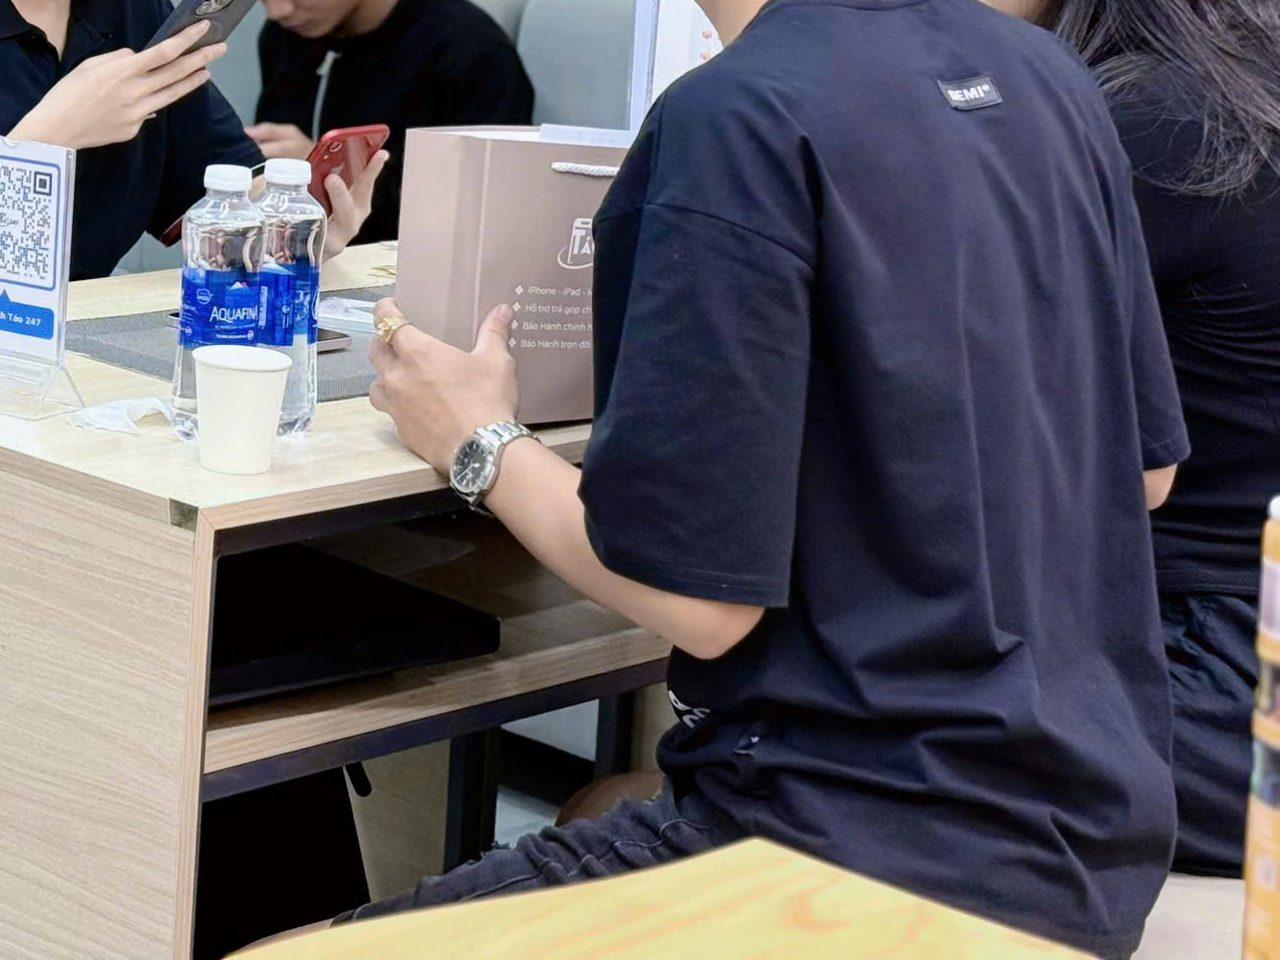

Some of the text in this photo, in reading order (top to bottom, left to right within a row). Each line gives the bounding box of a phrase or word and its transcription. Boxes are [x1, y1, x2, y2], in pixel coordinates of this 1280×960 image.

[527, 285, 557, 296] iPhone
[562, 287, 581, 296] iPad
[7, 312, 24, 324] Táo
[25, 315, 42, 327] 247
